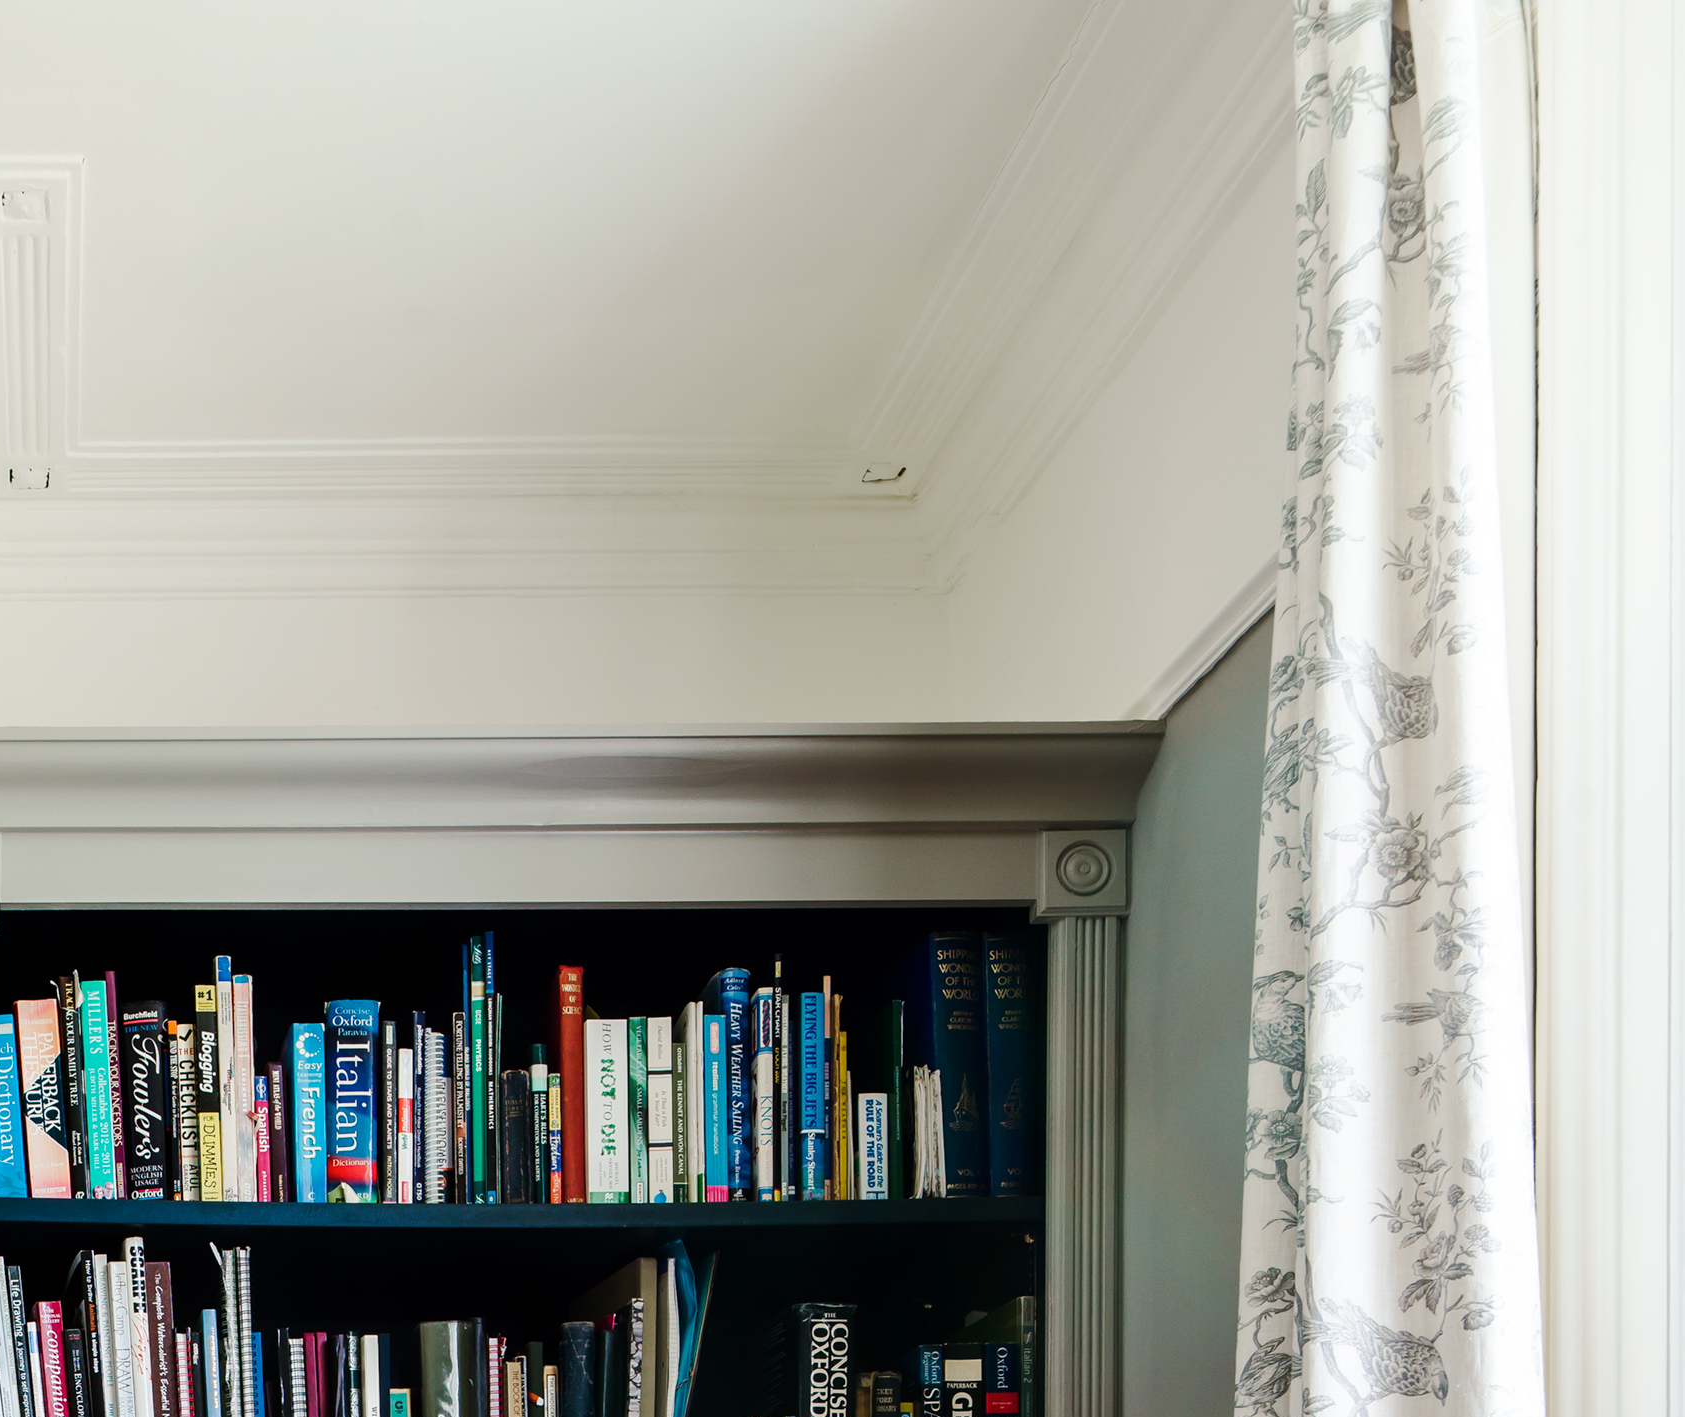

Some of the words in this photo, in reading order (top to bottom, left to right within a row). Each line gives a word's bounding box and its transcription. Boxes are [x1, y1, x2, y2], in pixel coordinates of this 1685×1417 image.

[64, 981, 74, 1020] TRACING
[335, 1006, 370, 1015] Concise
[88, 990, 103, 1054] MILLER'S
[123, 1011, 158, 1021] Burchfield
[124, 1025, 140, 1033] THE
[332, 1015, 372, 1027] Oxford
[730, 1002, 741, 1040] HEAVY
[804, 995, 817, 1040] FLYING
[66, 1021, 76, 1045] YOUR
[107, 1021, 117, 1063] TRACING
[338, 1028, 367, 1036] Paravia
[602, 1023, 612, 1055] HOW
[67, 1047, 77, 1078] FAMILY
[199, 1032, 215, 1093] Blogging
[297, 1060, 322, 1071] Easy
[731, 1043, 743, 1097] WEATHER
[804, 1043, 817, 1069] THE
[22, 1032, 44, 1136] THESAURUS
[38, 1032, 60, 1132] PAPERBACK
[109, 1064, 119, 1093] YOUR
[600, 1059, 616, 1100] NOT
[805, 1072, 817, 1096] BIG
[69, 1082, 78, 1106] TREE
[132, 1034, 162, 1160] Fowler's
[180, 1061, 197, 1150] CHECKLIST
[335, 1041, 372, 1154] Italian
[711, 1093, 719, 1122] grammar
[112, 1095, 122, 1146] ANCESTORS
[301, 1087, 321, 1159] French
[603, 1102, 613, 1121] TO
[732, 1101, 744, 1145] SAILING
[805, 1099, 817, 1128] JETS
[865, 1099, 874, 1122] RULE
[875, 1107, 883, 1141] Seaman's
[257, 1107, 270, 1152] Spanish
[600, 1124, 617, 1156] DIE
[866, 1125, 874, 1138] OF
[203, 1124, 217, 1188] DUMMIES
[550, 1134, 560, 1170] Italian
[805, 1133, 816, 1161] Stanley
[866, 1141, 874, 1158] THE
[130, 1164, 163, 1175] MODERN
[131, 1171, 163, 1181] ENGLISH
[332, 1157, 370, 1168] Dictionary
[807, 1161, 816, 1190] Stewart
[867, 1161, 875, 1188] ROAD
[876, 1166, 883, 1174] to
[135, 1178, 159, 1186] USAGE
[189, 1164, 198, 1191] ATUL
[131, 1189, 163, 1199] Oxford
[11, 1280, 21, 1298] Life
[111, 1271, 127, 1305] Jeffery
[129, 1246, 147, 1313] SCARFE
[154, 1273, 162, 1284] The
[154, 1285, 166, 1320] Complete
[12, 1299, 24, 1337] Drawing
[113, 1305, 127, 1336] Camp
[17, 1347, 26, 1372] journey
[156, 1323, 168, 1377] Watercolorist's
[1023, 1347, 1032, 1375] italian
[115, 1348, 132, 1394] DRAW
[512, 1370, 520, 1382] THE
[923, 1351, 932, 1385] Beginner's
[929, 1351, 940, 1384] Oxford
[996, 1347, 1008, 1388] Oxford
[160, 1379, 171, 1411] Essential
[211, 1380, 217, 1389] IN
[211, 1390, 219, 1409] LIFE
[513, 1406, 521, 1415] OF
